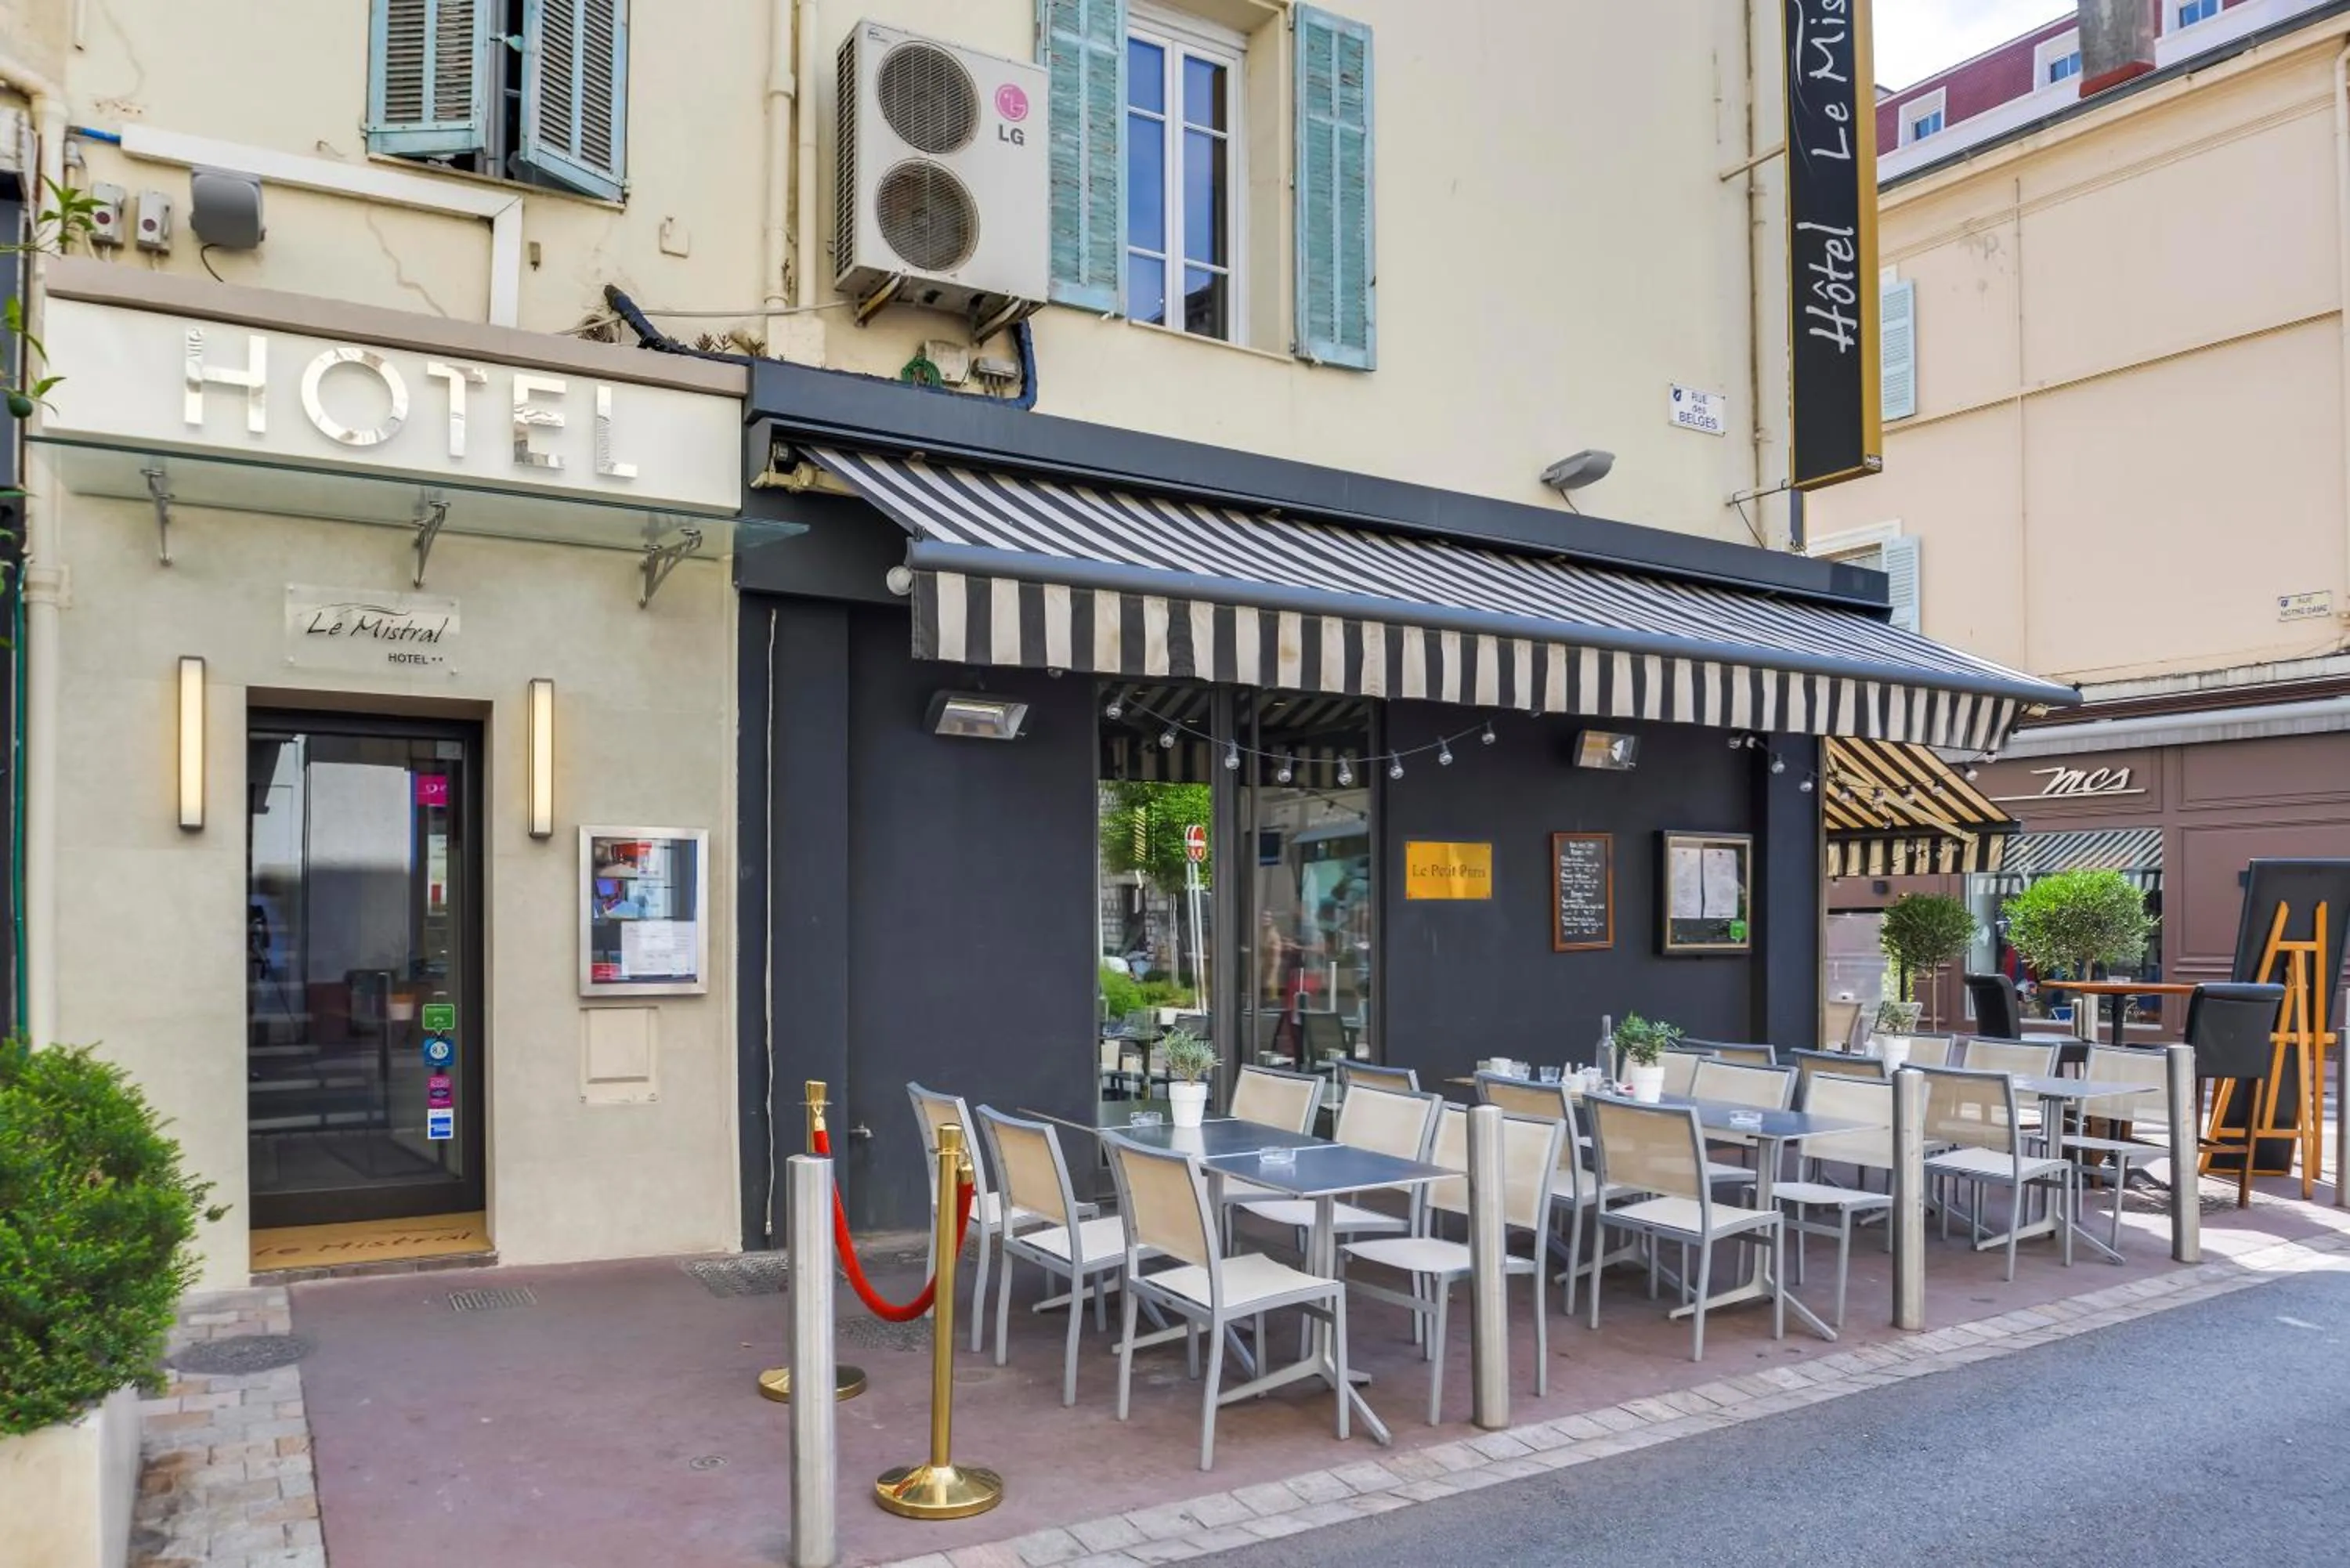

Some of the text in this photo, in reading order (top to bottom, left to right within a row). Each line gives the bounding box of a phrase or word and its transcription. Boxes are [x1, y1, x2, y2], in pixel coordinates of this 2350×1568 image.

[998, 124, 1025, 146] LG
[1810, 101, 1851, 160] Le
[1796, 222, 1857, 353] Hôtel
[185, 327, 638, 479] HOTEL
[1679, 411, 1718, 429] BELGES
[306, 611, 450, 643] Le Mistral
[388, 652, 428, 665] HOTEL
[1412, 864, 1486, 878] Le Petit Paris
